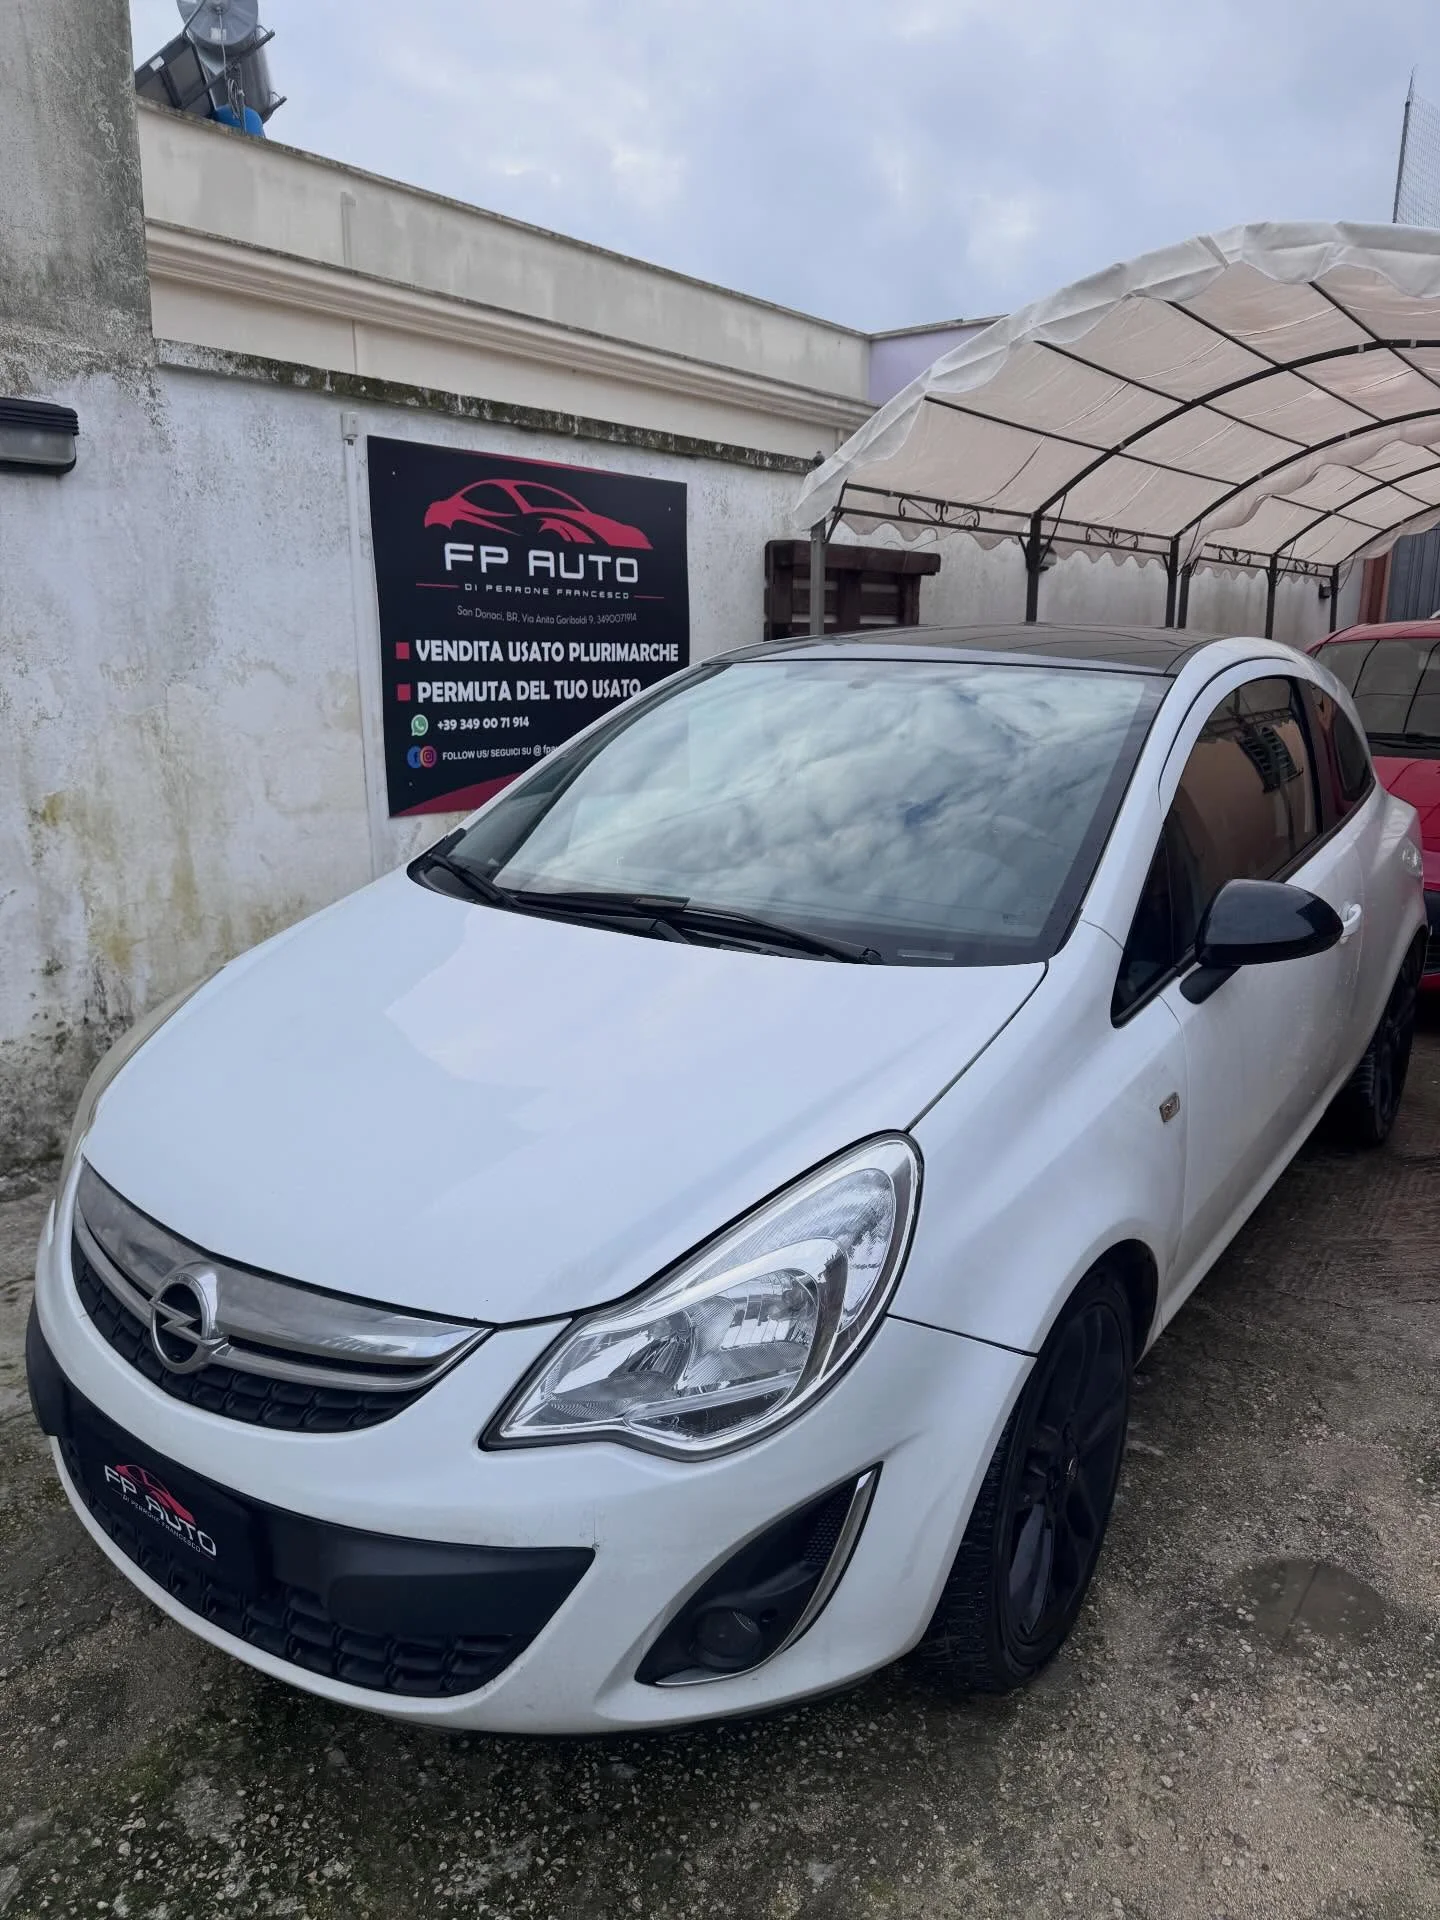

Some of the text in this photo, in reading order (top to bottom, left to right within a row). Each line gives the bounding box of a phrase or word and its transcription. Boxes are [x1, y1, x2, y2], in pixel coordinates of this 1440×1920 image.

[444, 542, 639, 584] FP AUTO
[464, 583, 630, 600] DI PERRONE FRANCESCO
[457, 605, 473, 617] San
[521, 613, 535, 624] Via
[536, 613, 555, 624] Anita
[556, 614, 588, 625] Garibaldi
[416, 639, 679, 663] VENDITA USATO PLURIMARCHE
[418, 678, 642, 704] PERMUTA DEL TUO USATO
[437, 716, 530, 731] +39 349 00 71 914
[442, 751, 475, 760] FOLLOW
[491, 748, 520, 757] SEGUICI
[521, 747, 532, 756] SU
[104, 1465, 216, 1556] FP AUTO
